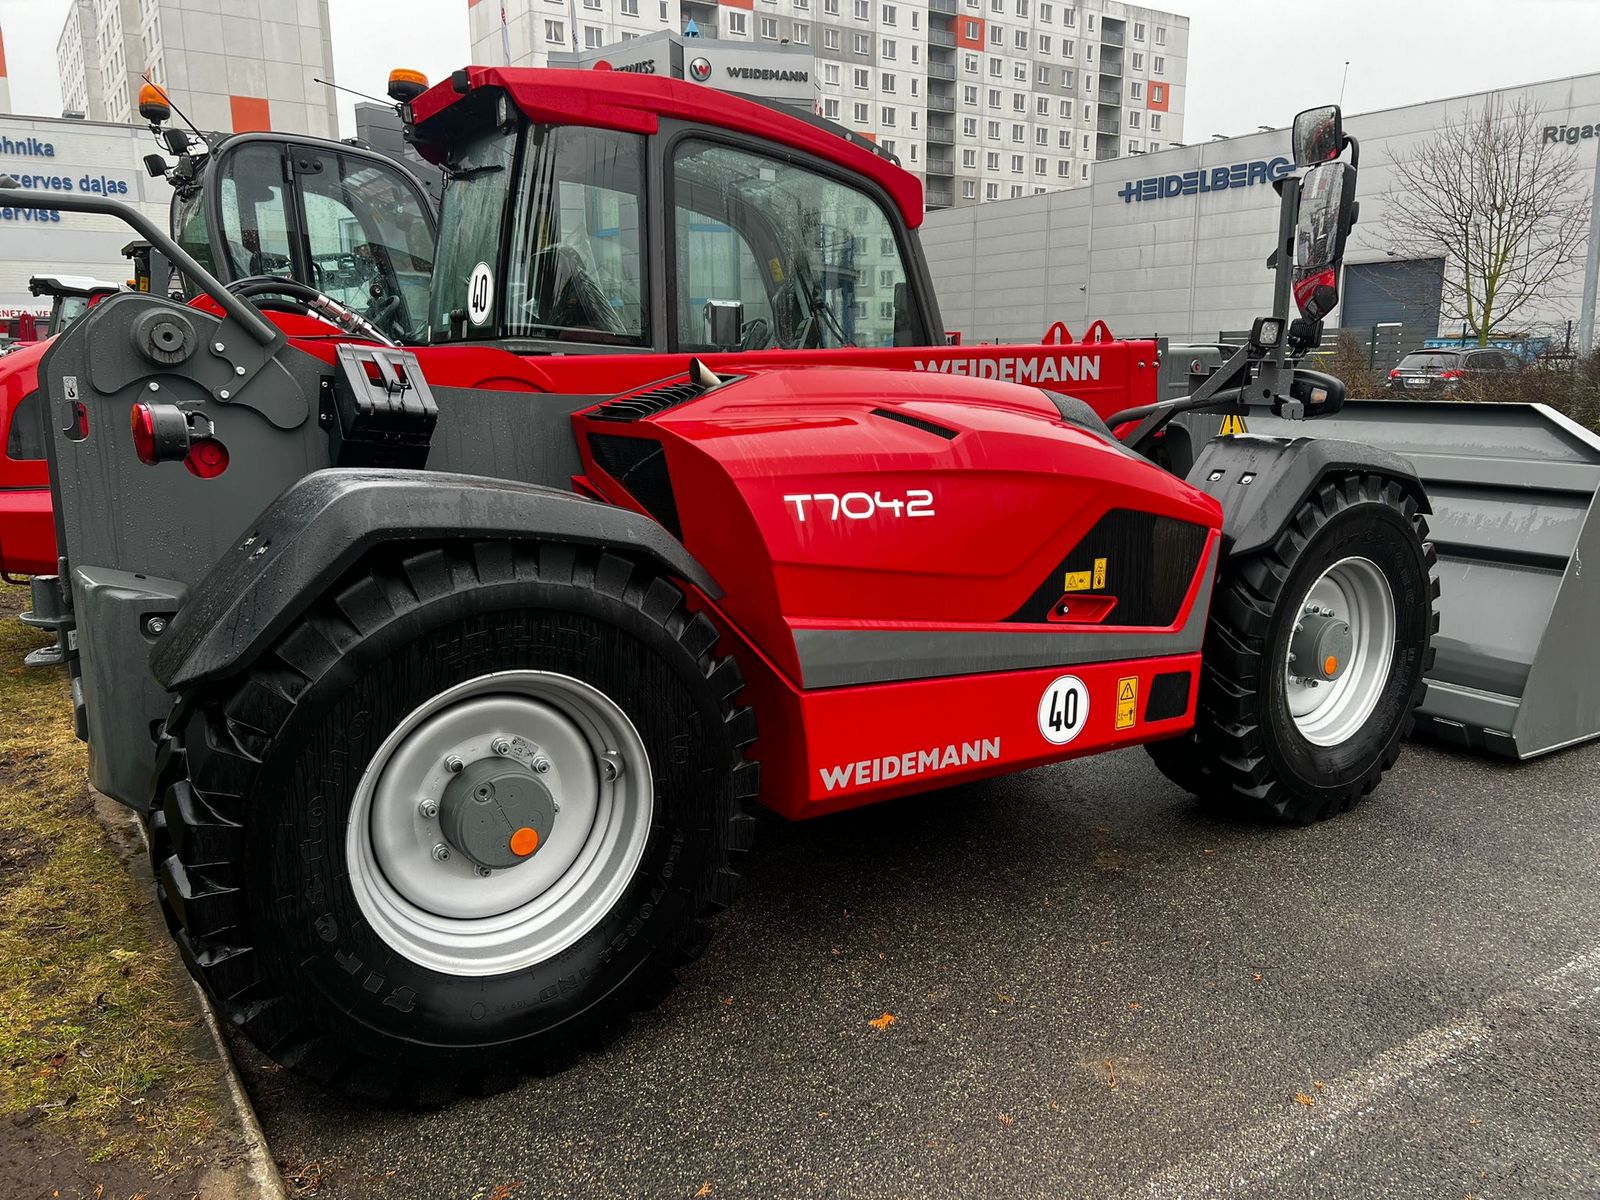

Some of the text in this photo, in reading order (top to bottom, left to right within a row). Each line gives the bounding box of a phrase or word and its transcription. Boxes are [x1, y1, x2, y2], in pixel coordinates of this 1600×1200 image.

[726, 66, 809, 82] WEIDEMANN
[0, 136, 55, 157] hnika
[79, 174, 128, 196] daļas
[1118, 156, 1296, 203] HEIDELBERG
[0, 207, 60, 222] erviss
[472, 274, 488, 313] 40
[783, 489, 935, 522] T7042
[1048, 687, 1079, 732] 40
[819, 736, 1000, 792] WEIDEMANN
